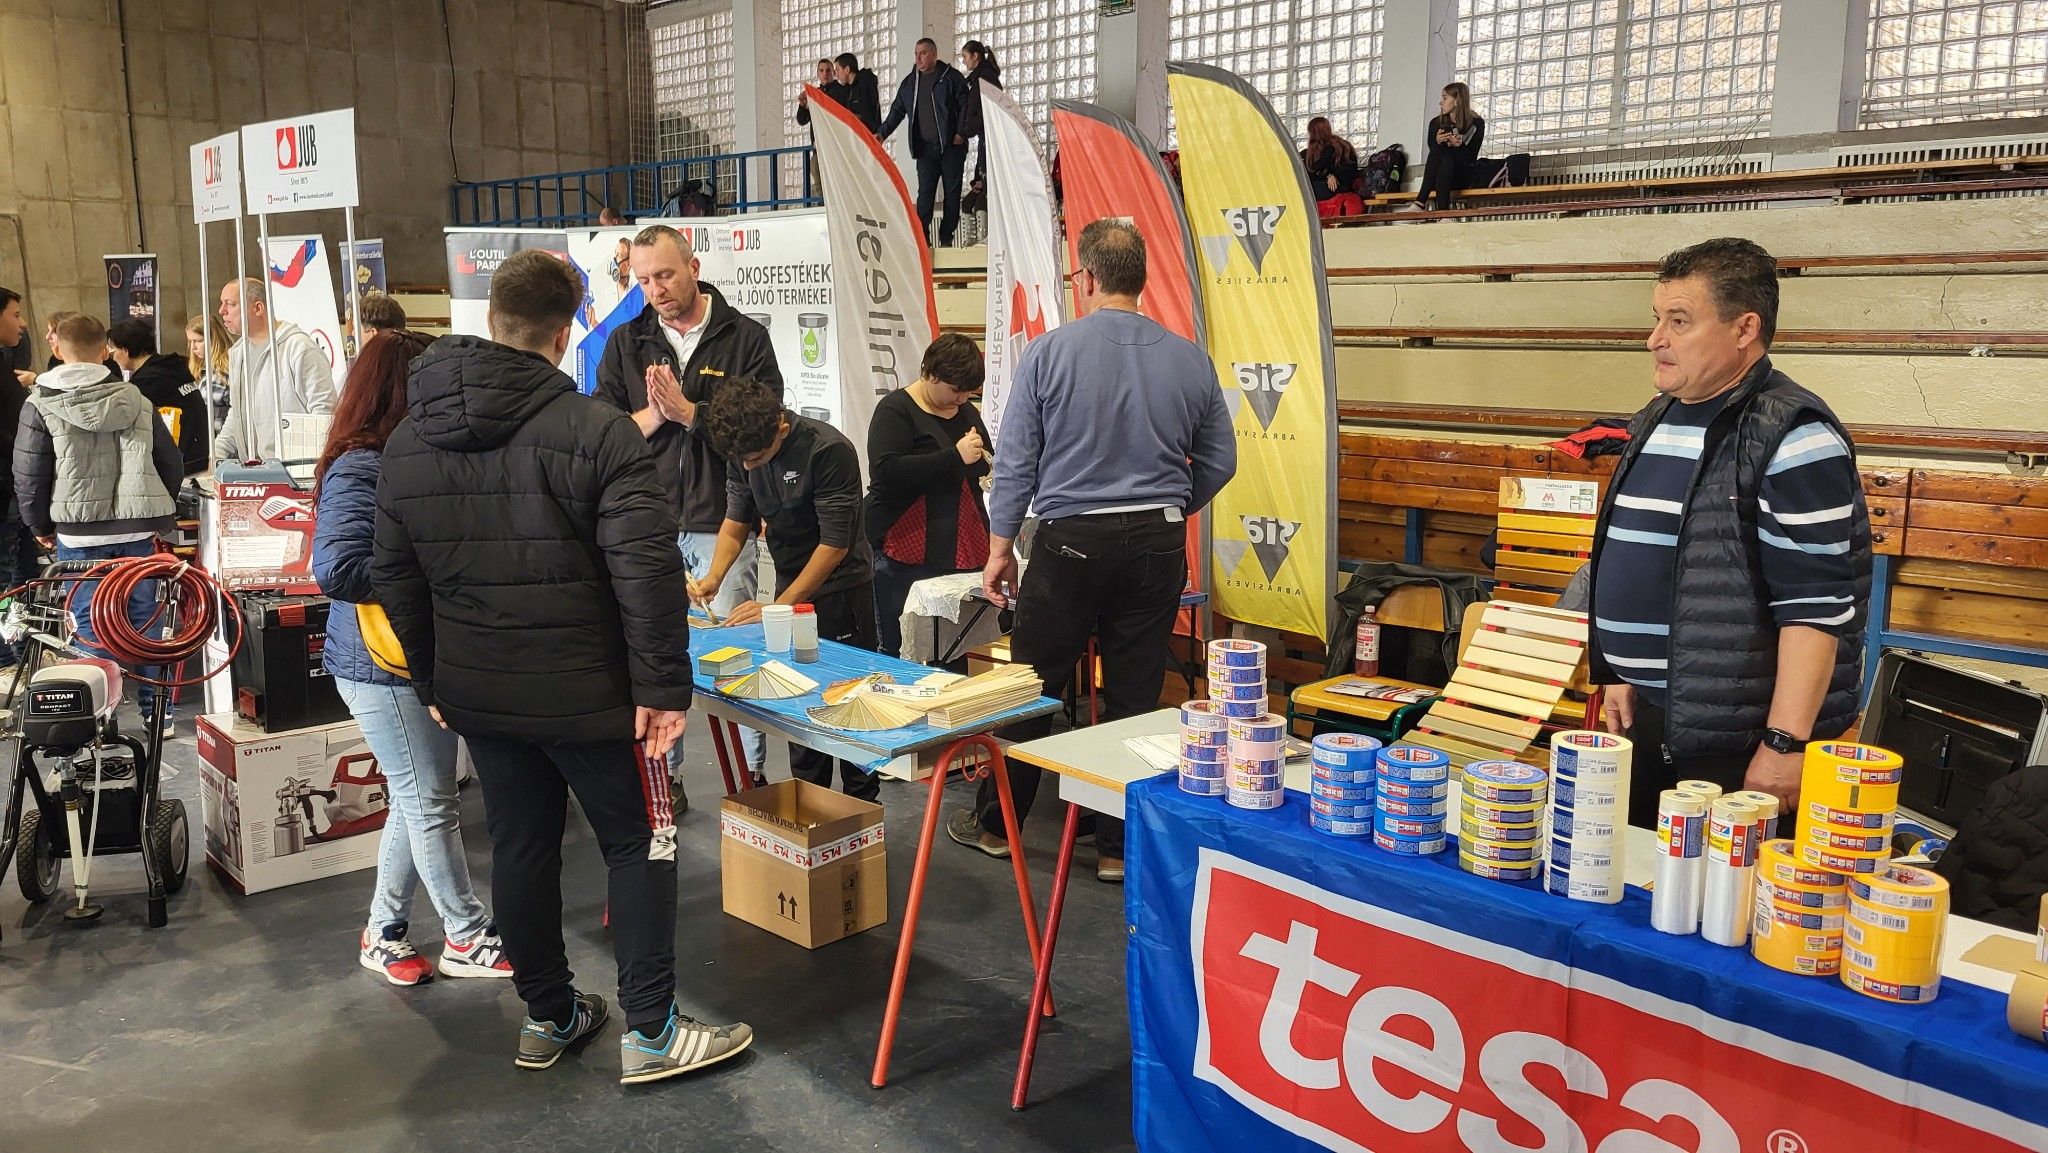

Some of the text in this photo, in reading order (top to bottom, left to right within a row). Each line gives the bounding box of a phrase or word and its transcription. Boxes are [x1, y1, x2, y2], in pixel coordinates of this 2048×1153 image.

[298, 124, 318, 168] JUB
[693, 227, 710, 253] JUB
[746, 229, 761, 251] JUB
[469, 248, 507, 260] L'OUTIL
[736, 261, 832, 285] OKOSFESTÉKEK
[737, 284, 832, 306] A JÖVŐ TERMÉKEI
[225, 486, 266, 498] TITAN
[45, 693, 74, 701] TITAN
[253, 744, 281, 754] TITAN
[1239, 920, 1743, 1153] tesa
